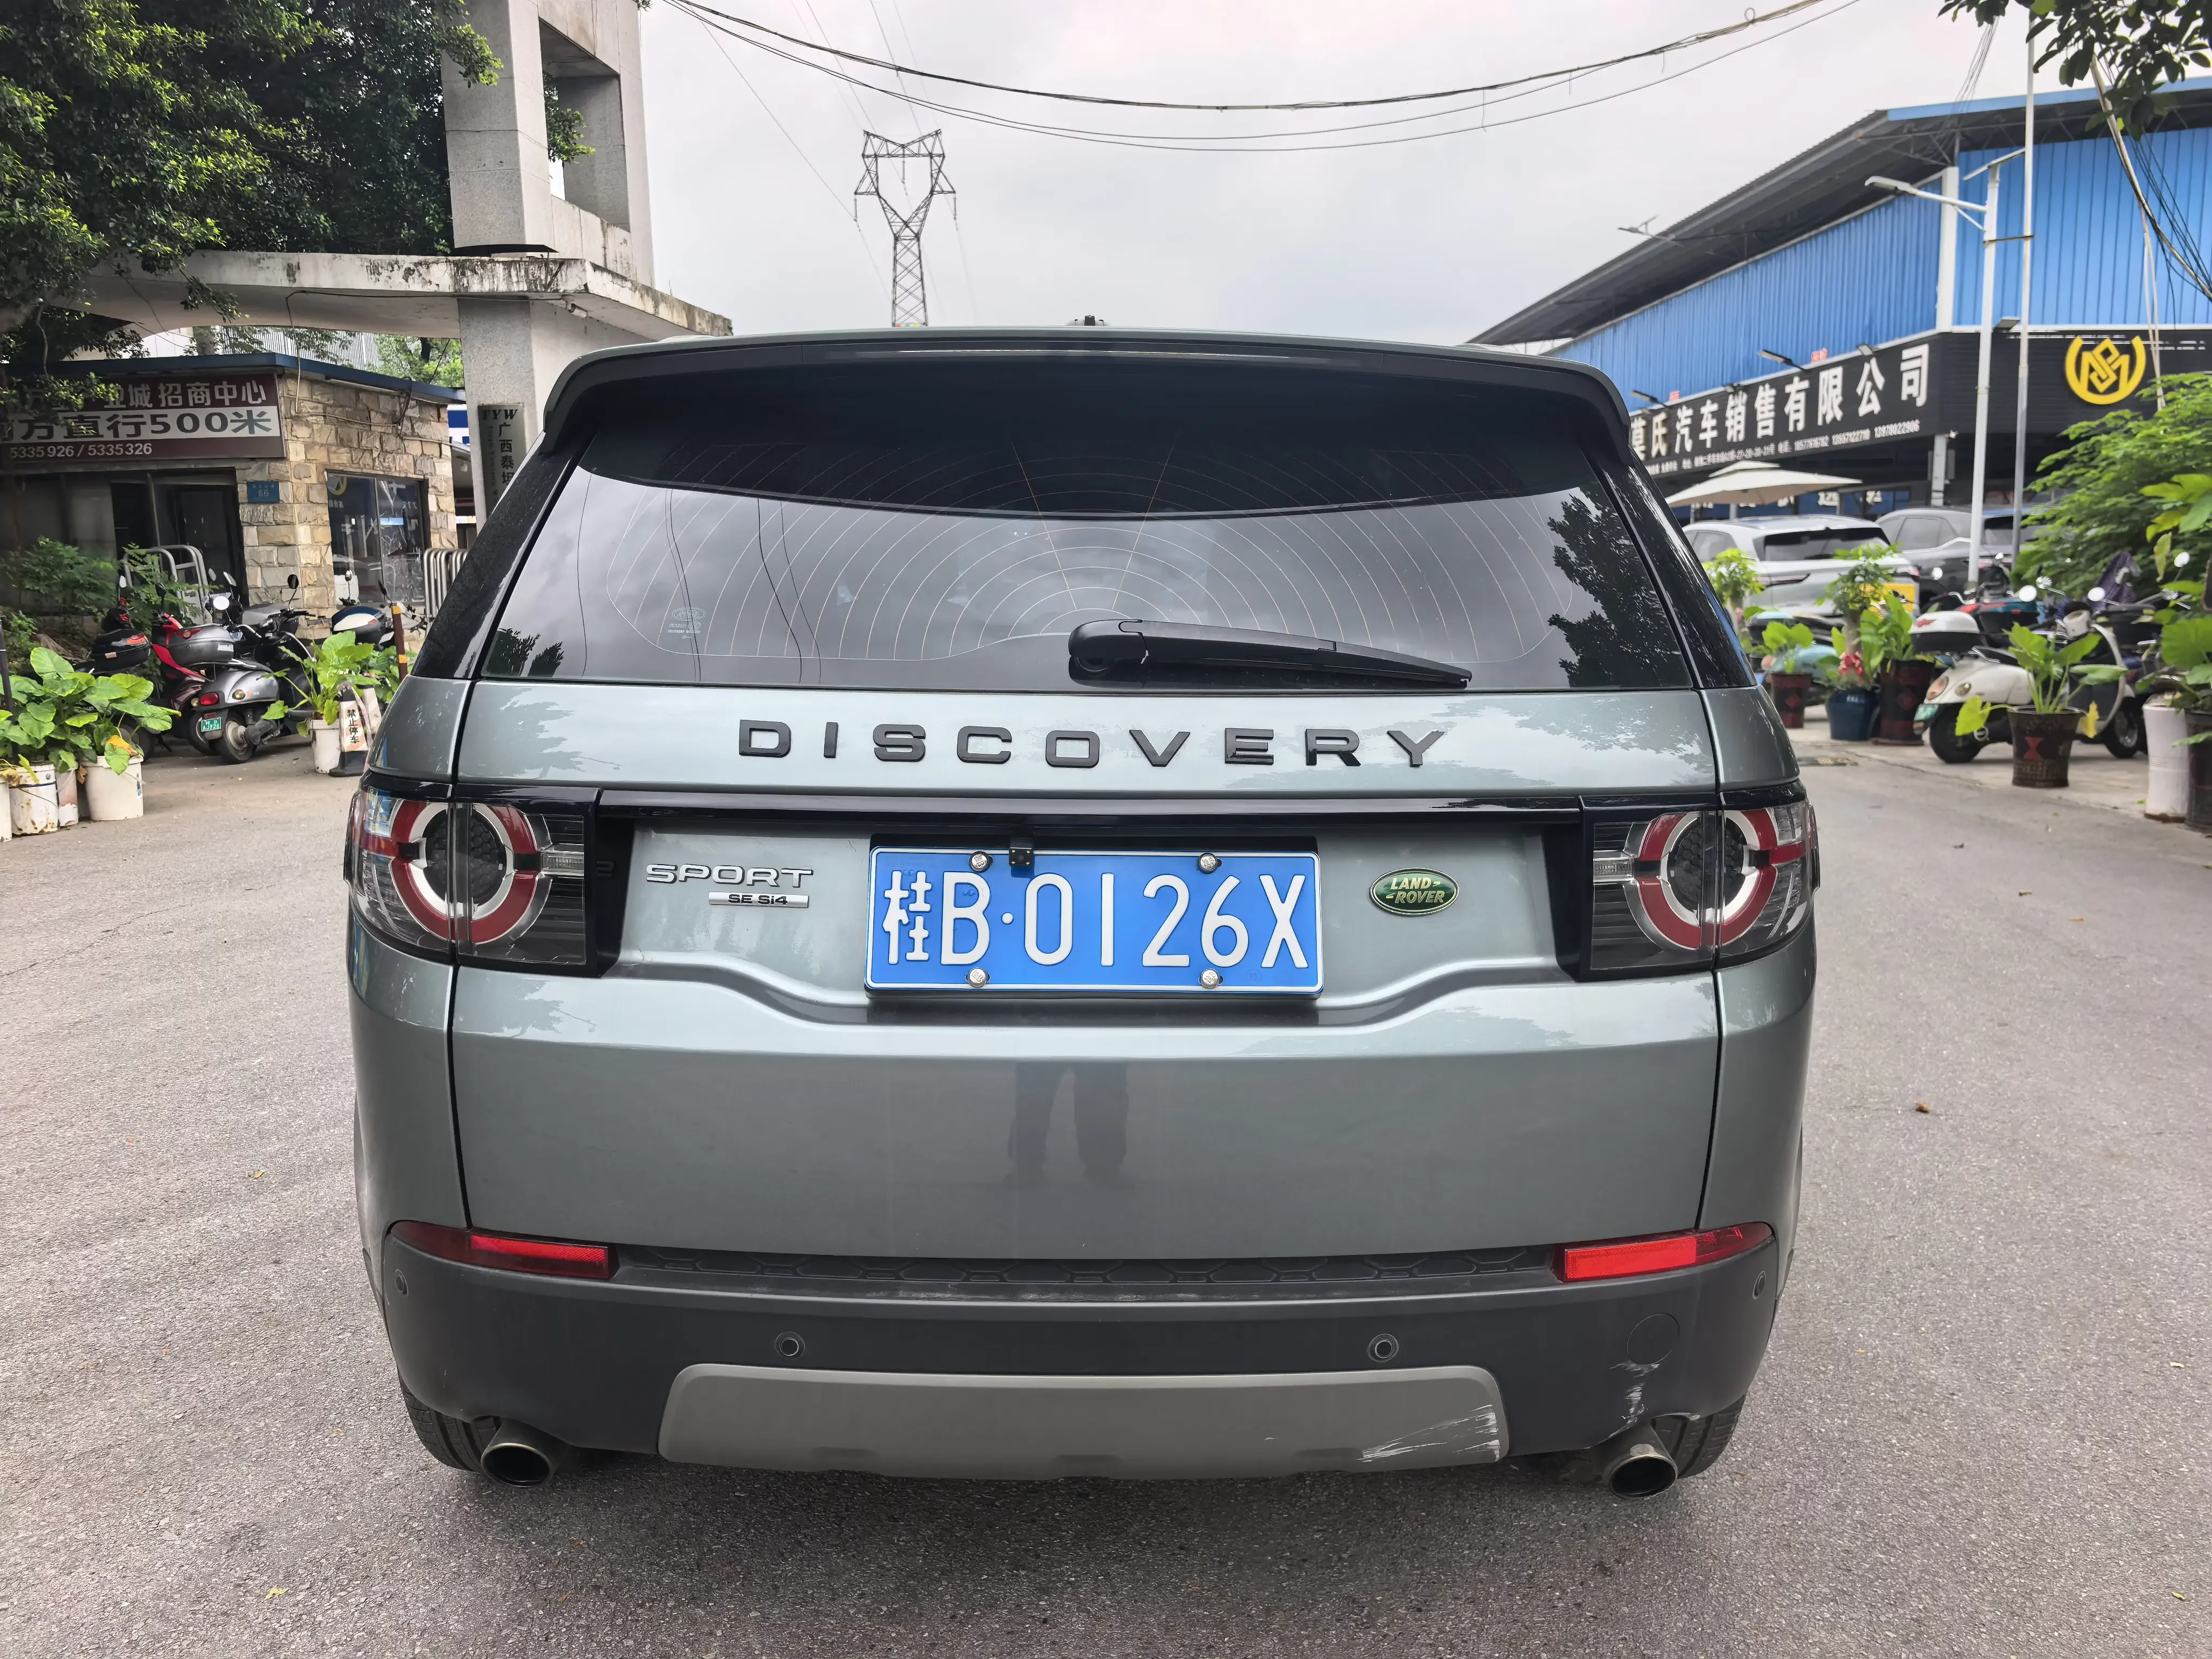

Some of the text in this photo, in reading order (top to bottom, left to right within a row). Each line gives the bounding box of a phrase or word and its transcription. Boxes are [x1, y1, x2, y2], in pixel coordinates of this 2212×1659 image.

[87, 443, 153, 456] 5335326
[347, 709, 360, 744] 禁止停车
[739, 719, 1445, 767] DISCOVERY
[646, 864, 814, 888] SPORT
[1391, 877, 1432, 890] LAND
[729, 894, 788, 905] SE Si4
[1395, 891, 1445, 903] ROVER
[882, 871, 1309, 968] 桂B·0126X
